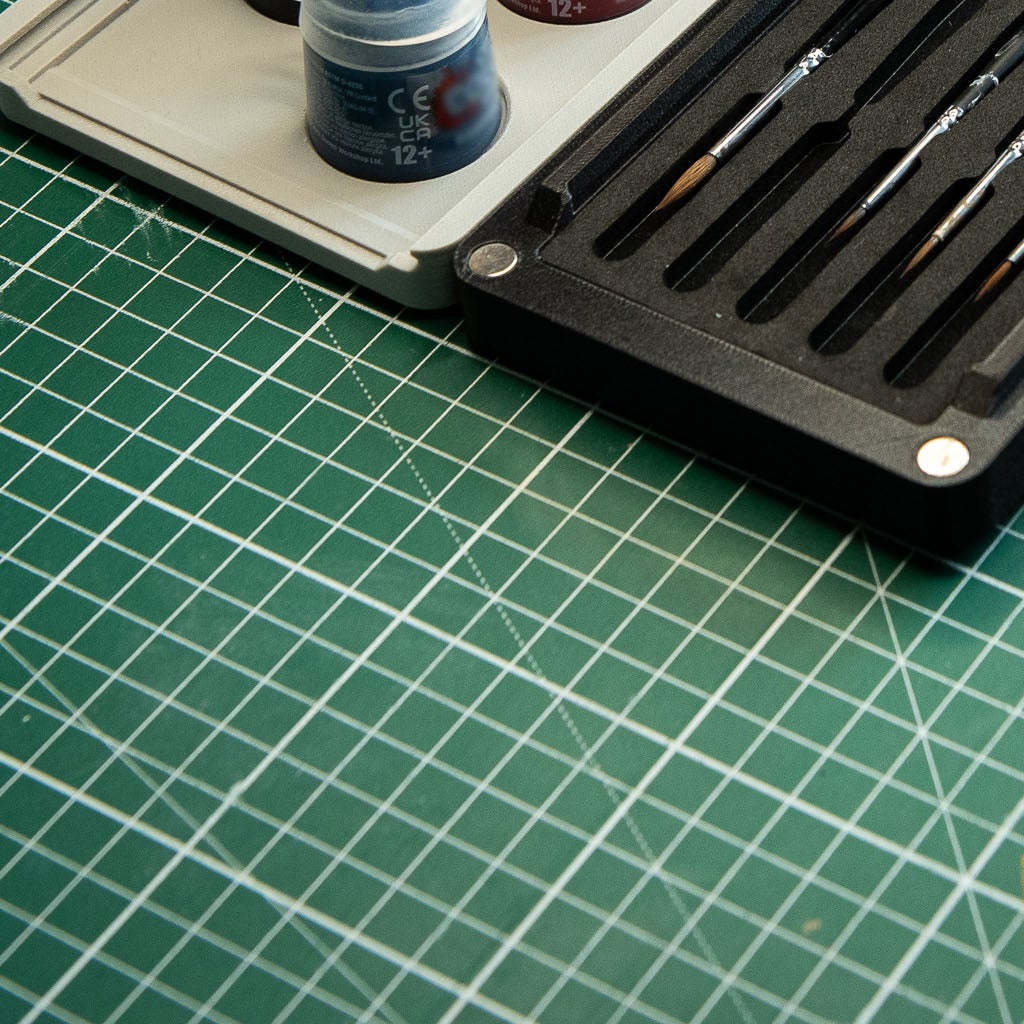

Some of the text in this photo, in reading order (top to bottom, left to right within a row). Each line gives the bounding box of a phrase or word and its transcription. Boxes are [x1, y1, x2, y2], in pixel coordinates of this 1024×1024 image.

[387, 84, 432, 114] CE
[399, 114, 431, 129] UK
[399, 128, 432, 143] CA
[390, 144, 432, 166] 12+
